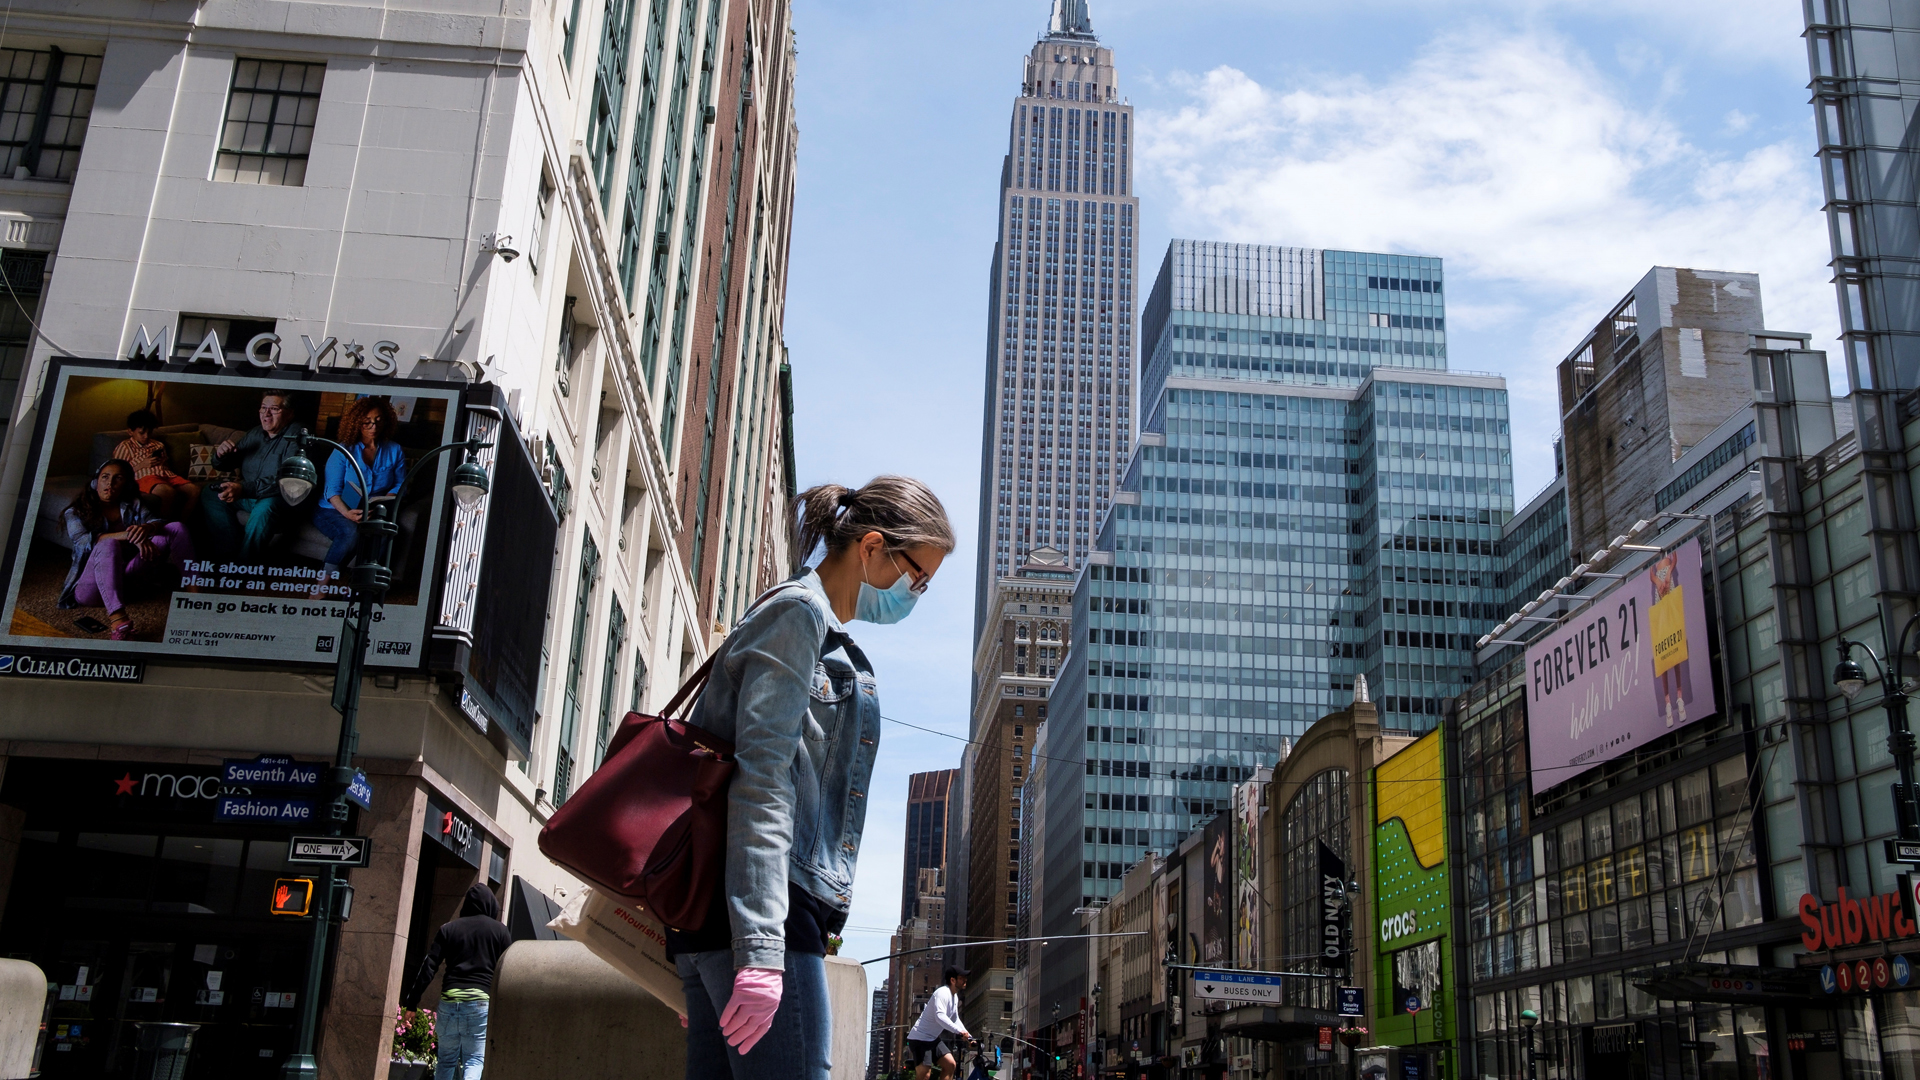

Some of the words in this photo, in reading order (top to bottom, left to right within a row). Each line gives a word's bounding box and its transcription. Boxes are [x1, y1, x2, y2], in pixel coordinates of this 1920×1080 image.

[183, 559, 215, 573] Talk
[218, 562, 265, 576] about
[267, 564, 326, 581] making
[330, 571, 340, 580] a
[181, 574, 215, 588] plan
[219, 577, 243, 589] for
[246, 580, 266, 590] an
[175, 598, 212, 610] Then
[216, 601, 237, 614] go
[240, 601, 277, 614] back
[281, 604, 298, 615] to
[301, 606, 327, 618] not
[330, 607, 386, 622] talkg.
[191, 630, 276, 642] NYC.GOV/READYNY
[317, 637, 333, 648] ad
[1655, 632, 1676, 657] FOREVER
[1677, 629, 1683, 642] 21
[1533, 616, 1611, 702] FOREVER
[1618, 597, 1639, 653] 21
[1570, 682, 1600, 740] hello
[1603, 632, 1640, 711] NYC!
[228, 766, 286, 784] Seventh
[291, 769, 317, 783] Ave
[223, 801, 278, 817] Fashion
[282, 803, 310, 818] Ave
[303, 844, 322, 854] ONE
[331, 846, 352, 855] WAY
[1905, 847, 1920, 855] ONE
[614, 907, 667, 946] #NourishYo
[1382, 909, 1416, 942] crocs
[1799, 886, 1916, 951] Subwa
[1325, 924, 1340, 958] OLD
[1859, 965, 1869, 985] 2
[1876, 963, 1886, 983] 3
[1893, 963, 1908, 980] MTA
[1224, 987, 1249, 996] BUSES
[1252, 988, 1272, 997] ONLY
[1761, 984, 1787, 992] Subway
